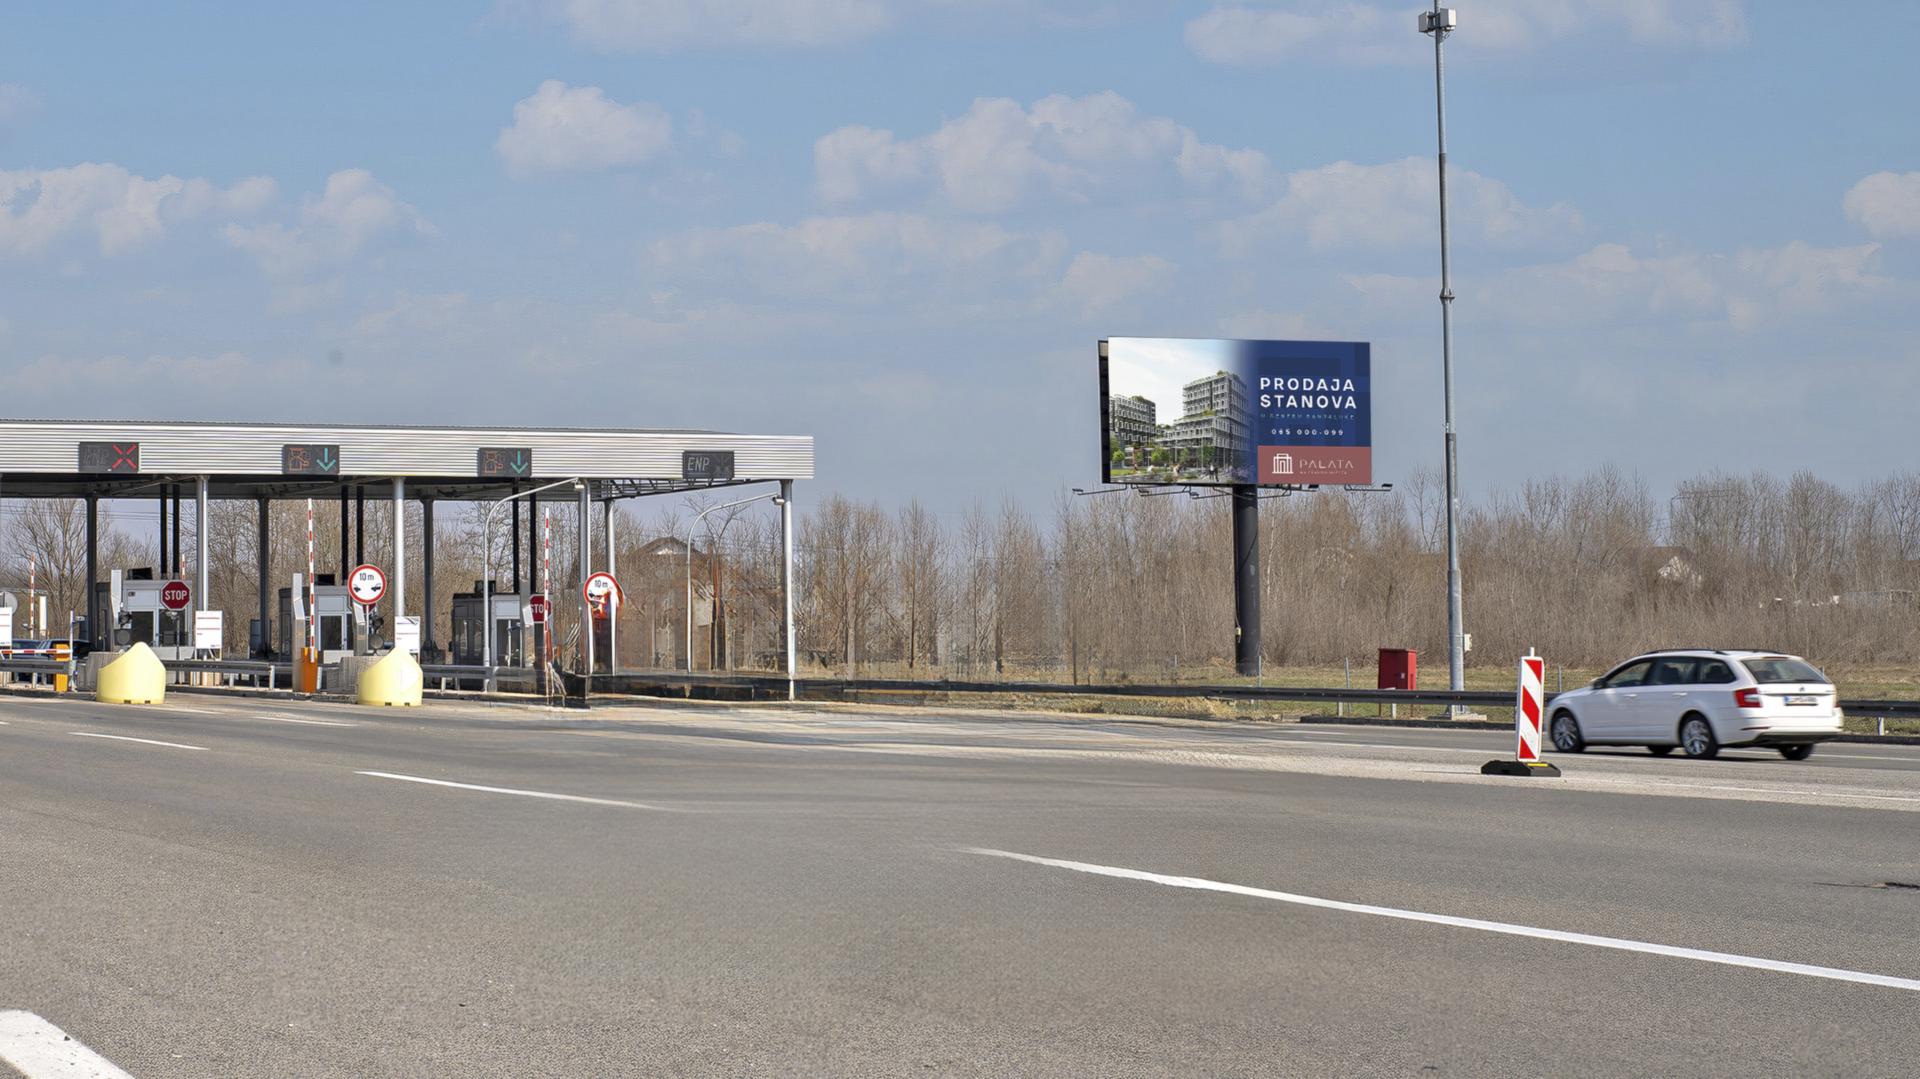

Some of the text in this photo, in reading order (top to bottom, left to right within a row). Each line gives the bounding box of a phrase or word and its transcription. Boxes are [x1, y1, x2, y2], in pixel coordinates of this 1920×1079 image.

[1260, 377, 1355, 392] PRODAJA
[1260, 394, 1357, 409] STANOVA
[687, 457, 711, 471] ENP
[1299, 459, 1354, 469] PALATA
[359, 572, 367, 581] 10
[164, 590, 188, 600] STOP
[530, 604, 545, 613] STO
